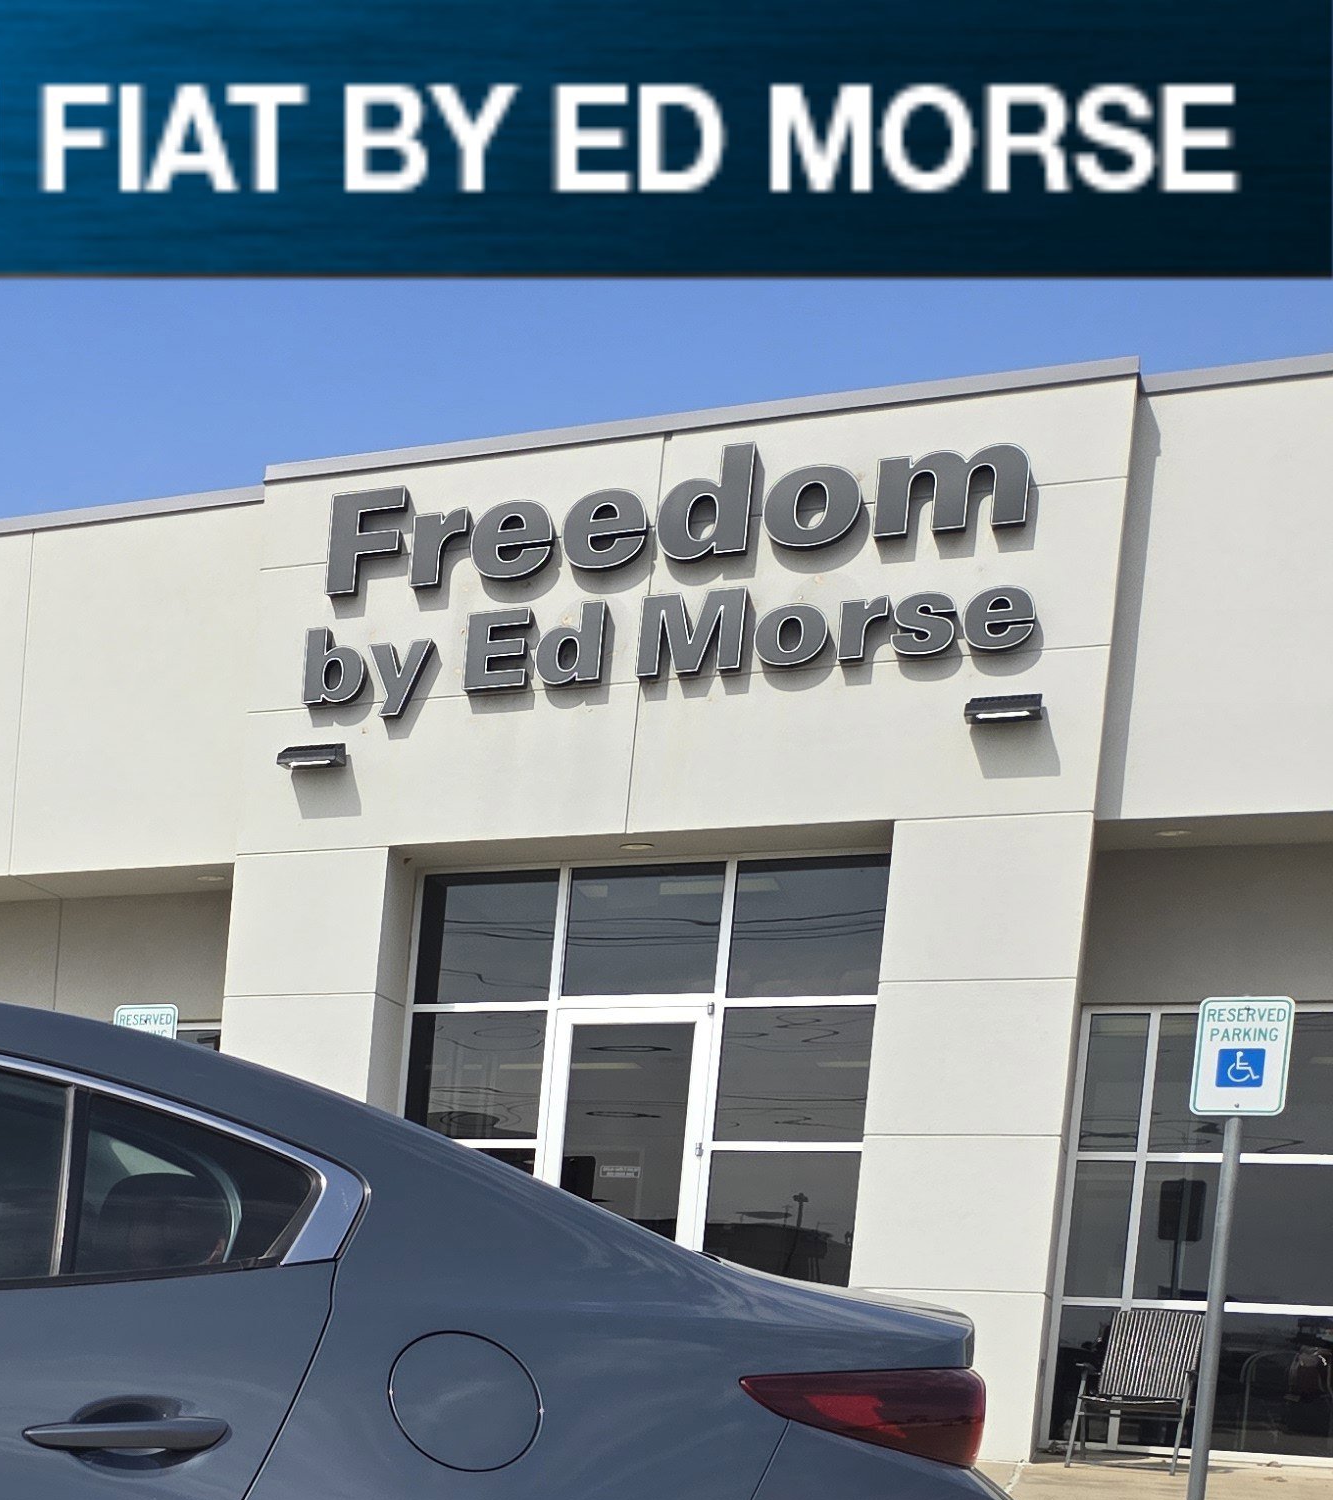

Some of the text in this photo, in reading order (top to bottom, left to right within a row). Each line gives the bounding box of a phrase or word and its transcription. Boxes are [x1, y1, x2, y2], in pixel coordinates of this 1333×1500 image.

[324, 442, 1032, 597] Freedom
[301, 585, 1037, 718] by Ed Morse
[119, 1013, 173, 1026] RESERVED
[1206, 1007, 1287, 1023] RESERVED
[1209, 1027, 1279, 1042] PARKING
